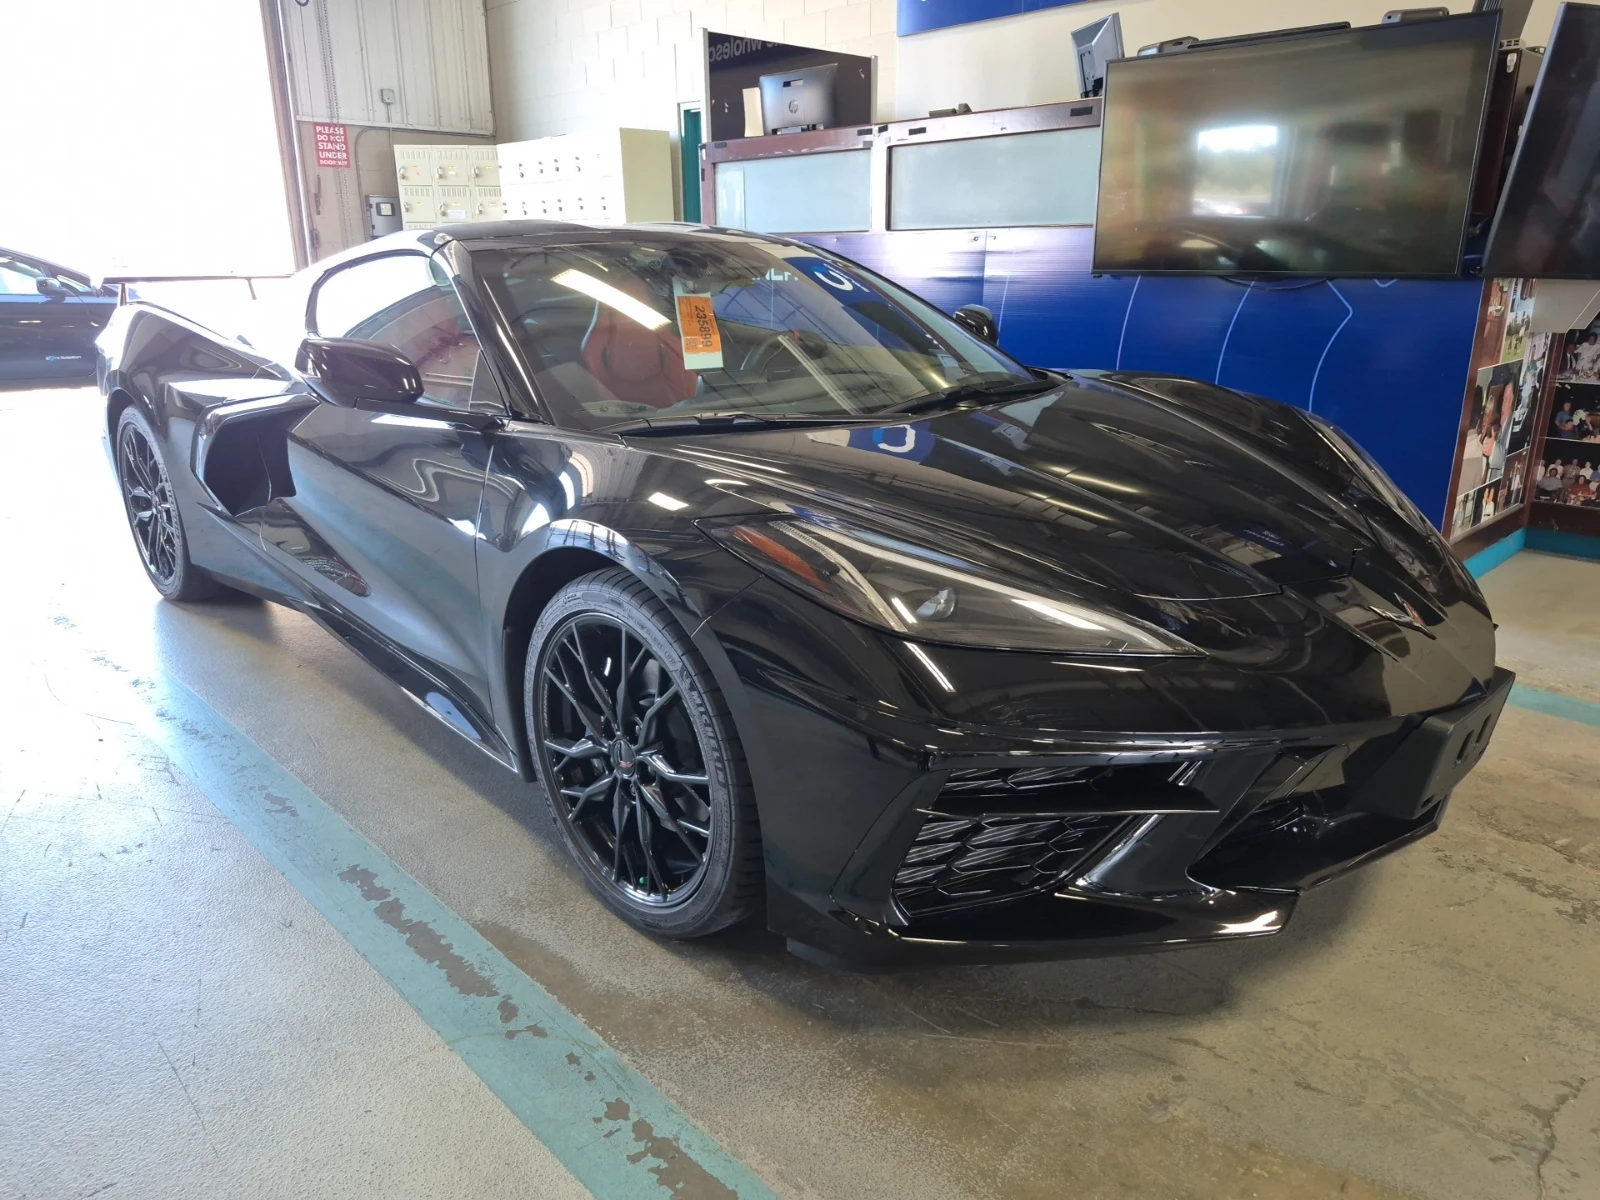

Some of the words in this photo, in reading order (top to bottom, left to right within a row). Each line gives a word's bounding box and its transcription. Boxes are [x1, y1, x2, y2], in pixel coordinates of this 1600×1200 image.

[316, 126, 344, 135] PLEASE
[318, 142, 346, 150] STAND
[319, 151, 347, 160] UNDER
[695, 304, 713, 348] 235899
[690, 690, 728, 786] MICHELIN
